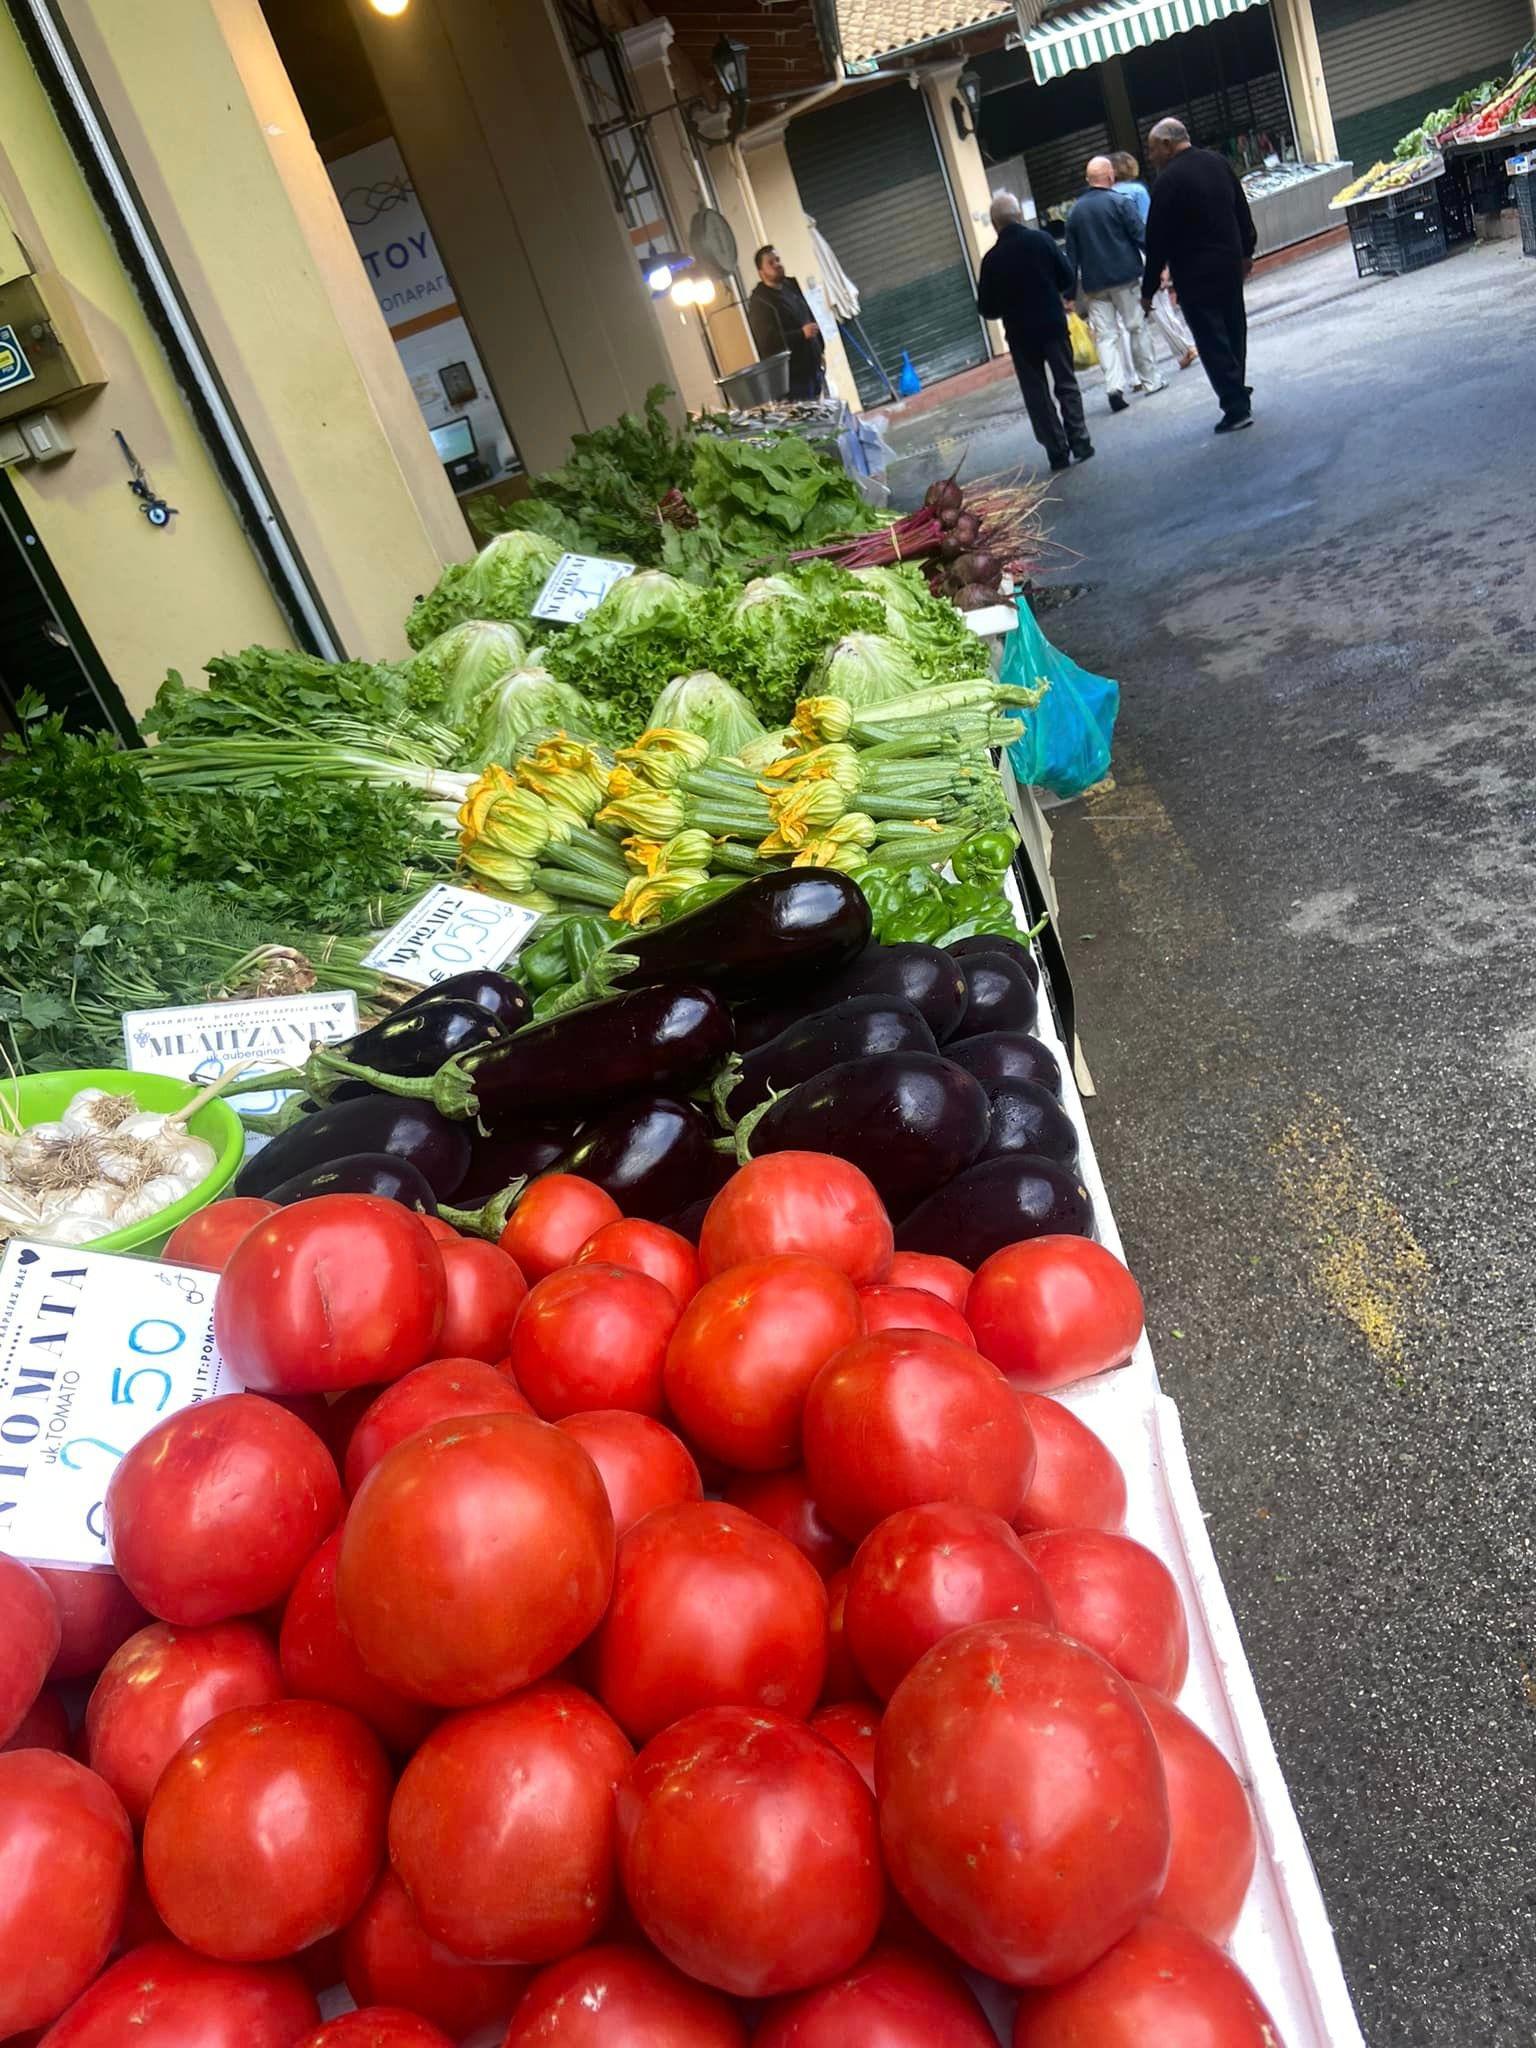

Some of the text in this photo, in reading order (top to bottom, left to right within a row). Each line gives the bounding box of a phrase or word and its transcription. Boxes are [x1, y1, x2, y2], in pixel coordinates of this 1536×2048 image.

[364, 231, 427, 278] ΤΟΥ
[222, 1046, 286, 1061] aubergines
[14, 1268, 28, 1288] ΜΑΣ
